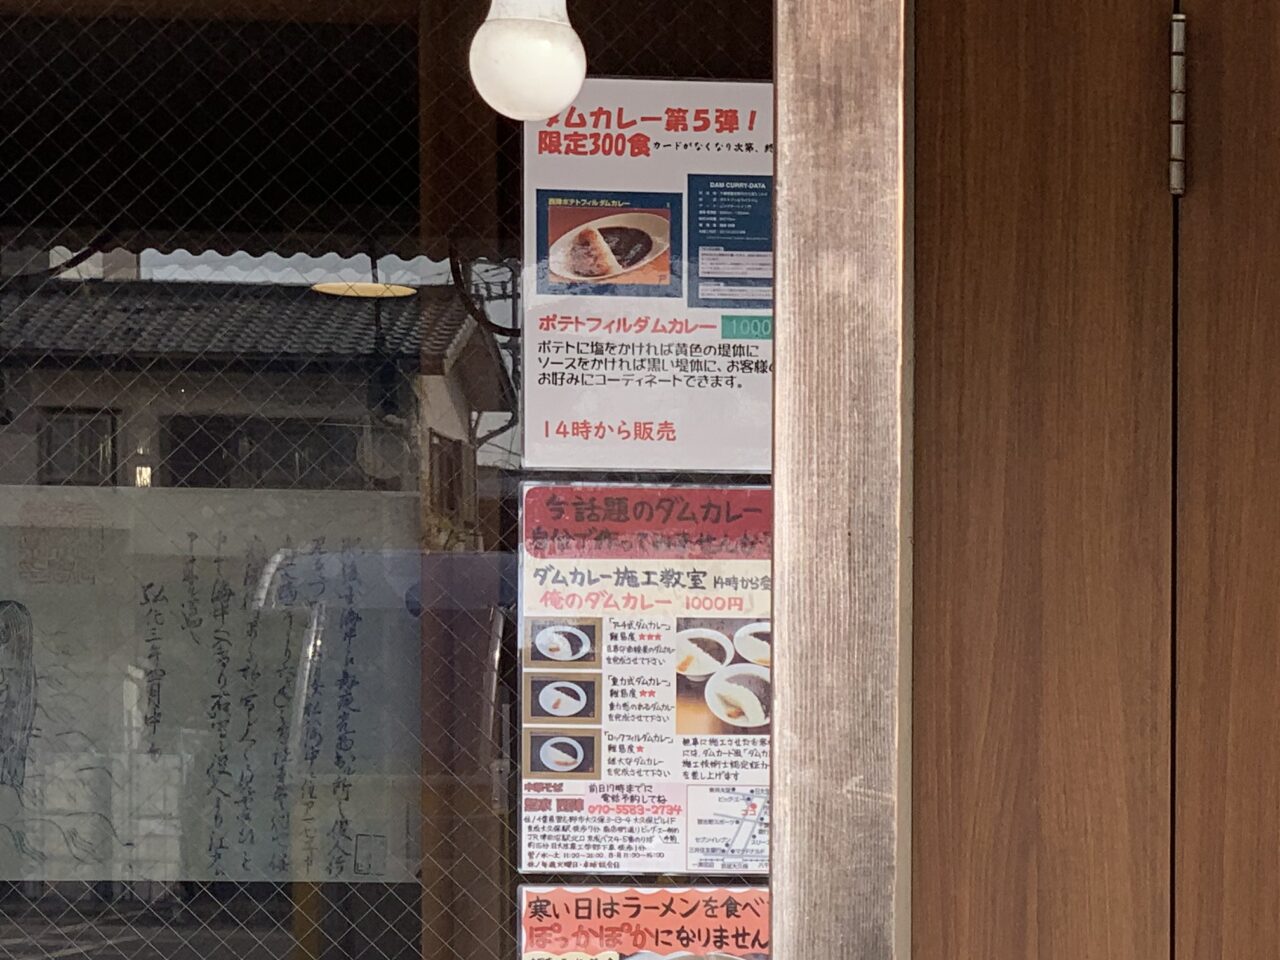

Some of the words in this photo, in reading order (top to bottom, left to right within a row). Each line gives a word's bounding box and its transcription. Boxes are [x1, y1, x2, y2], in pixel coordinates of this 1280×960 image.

[537, 130, 651, 157] 限定300食
[538, 314, 717, 335] ポテトフィルダムカレー
[537, 340, 759, 358] ポテトに塩をかければ黄色の堤体に
[537, 372, 743, 389] お好みにコーディネートできます。
[544, 419, 677, 441] 14時から販売
[546, 494, 762, 524] 今話題のダムカレー
[533, 565, 708, 590] ダムカレー施工教室
[539, 590, 673, 613] 俺のダムカレー
[685, 596, 745, 612] 1000円
[527, 895, 769, 923] 寒い日はラーメンを食べ
